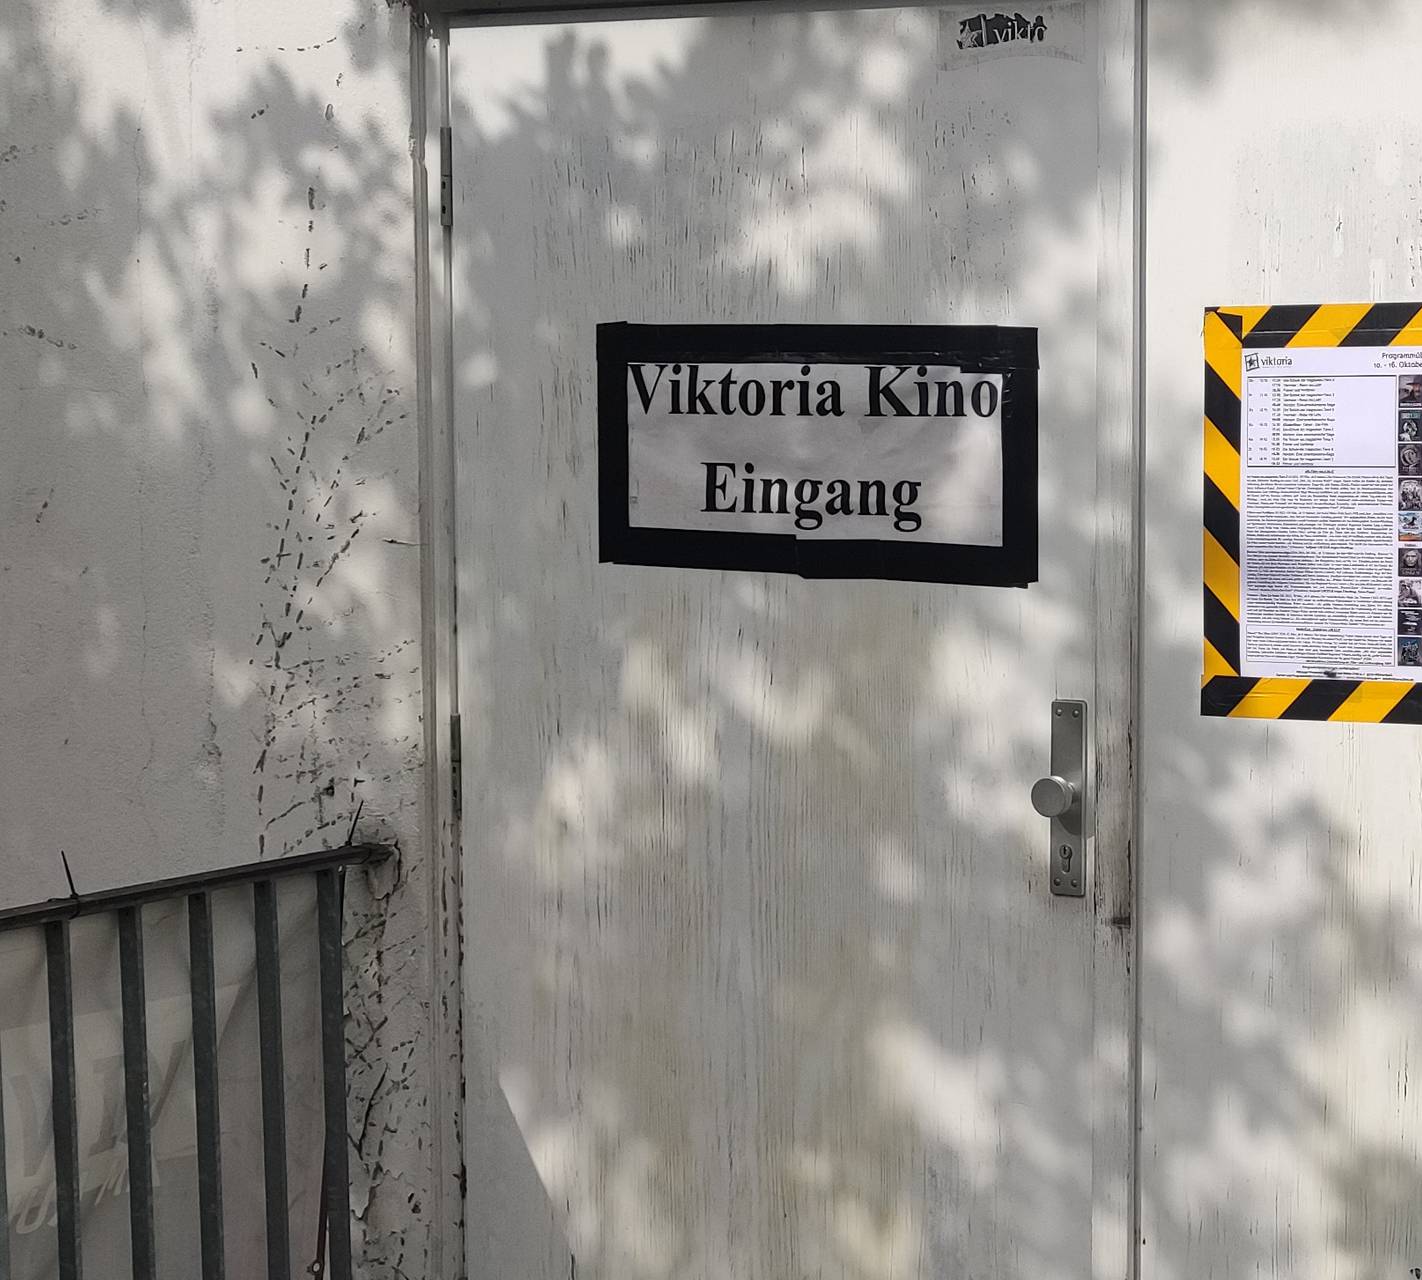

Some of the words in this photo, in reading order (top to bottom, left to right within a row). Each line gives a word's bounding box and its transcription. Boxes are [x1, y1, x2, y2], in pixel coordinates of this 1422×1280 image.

[1260, 356, 1293, 366] viktoria
[627, 364, 845, 417] Viktoria
[863, 365, 1000, 418] Kino
[700, 461, 922, 532] Eingang
